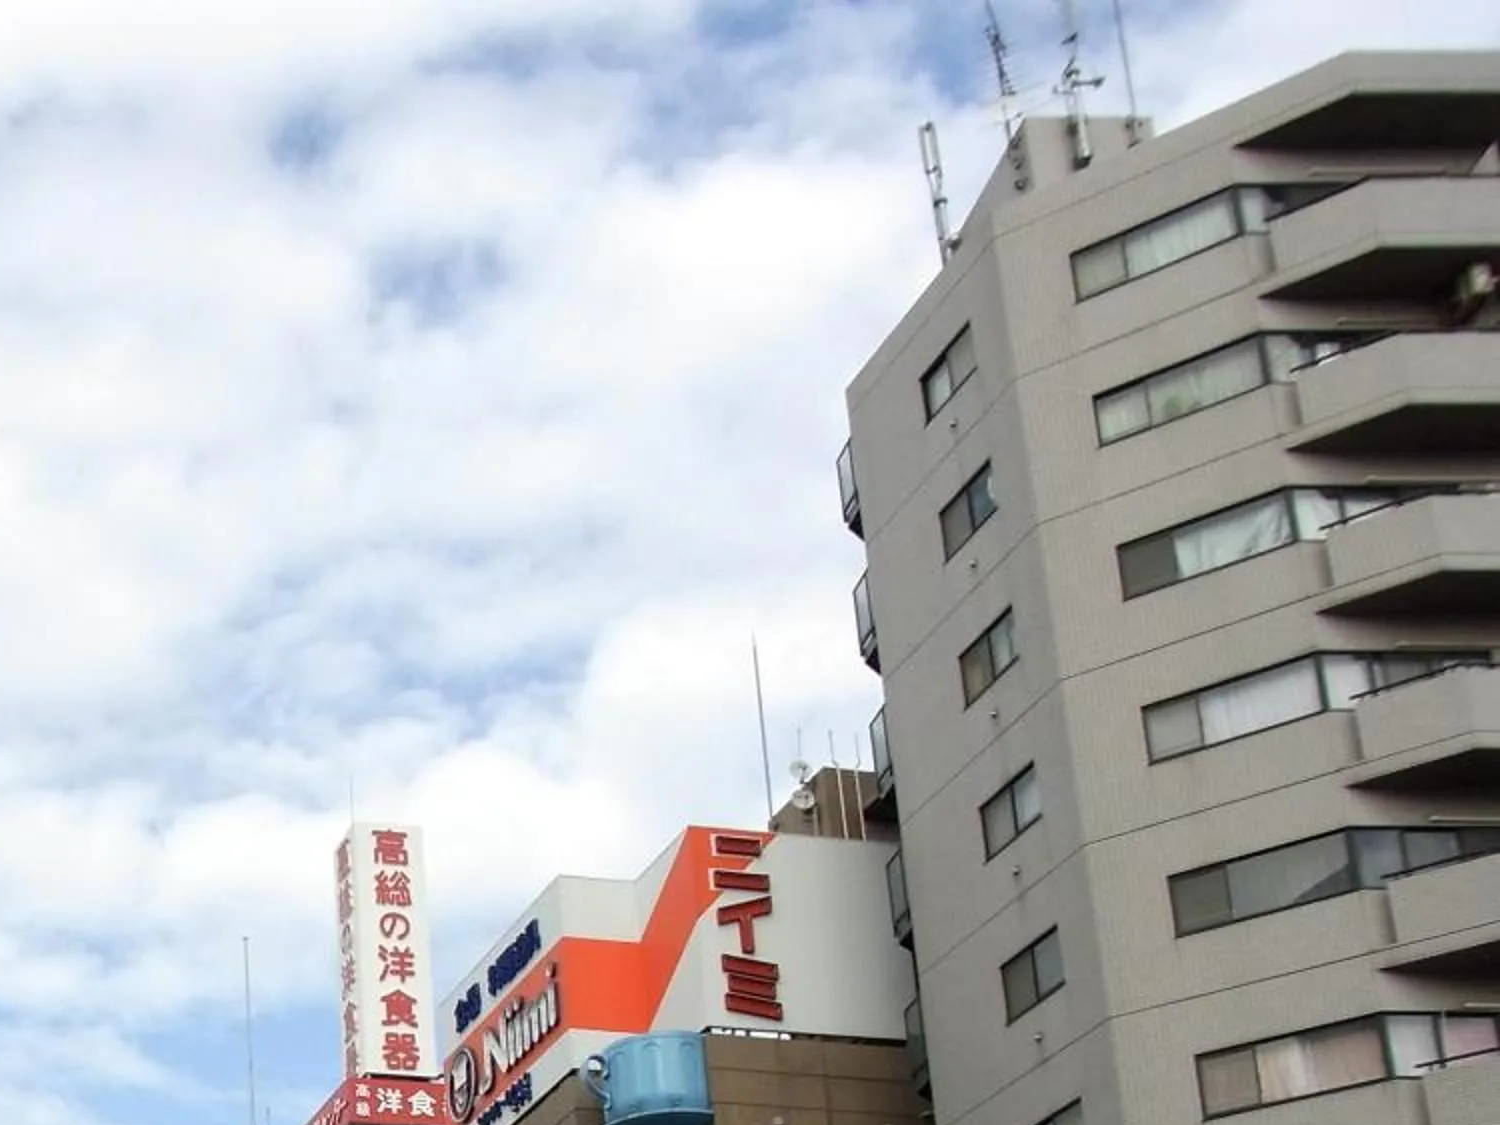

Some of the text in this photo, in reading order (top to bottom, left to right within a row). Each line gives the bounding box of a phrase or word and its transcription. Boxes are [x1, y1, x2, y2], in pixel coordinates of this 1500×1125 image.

[372, 829, 421, 1071] 高総の洋食器
[712, 834, 784, 1021] ニイミ
[479, 961, 561, 1096] Niimi
